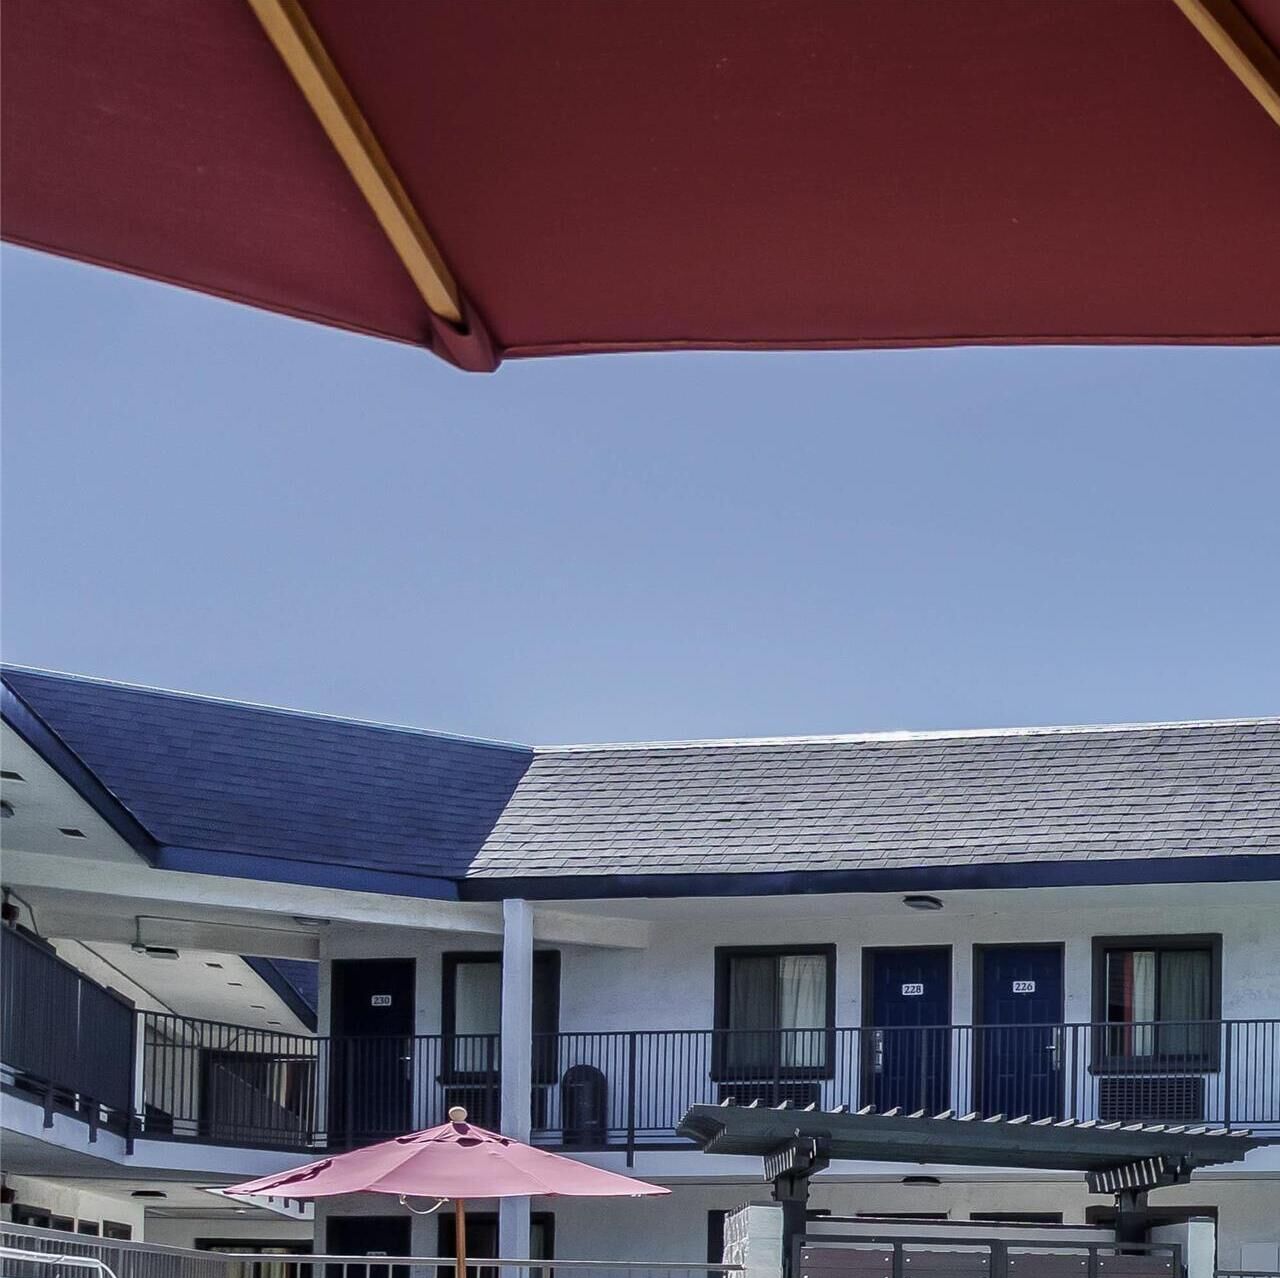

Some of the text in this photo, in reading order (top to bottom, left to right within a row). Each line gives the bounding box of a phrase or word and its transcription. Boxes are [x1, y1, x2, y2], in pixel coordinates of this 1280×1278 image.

[904, 985, 921, 994] 228
[1015, 982, 1033, 991] 226
[373, 996, 390, 1005] 230
